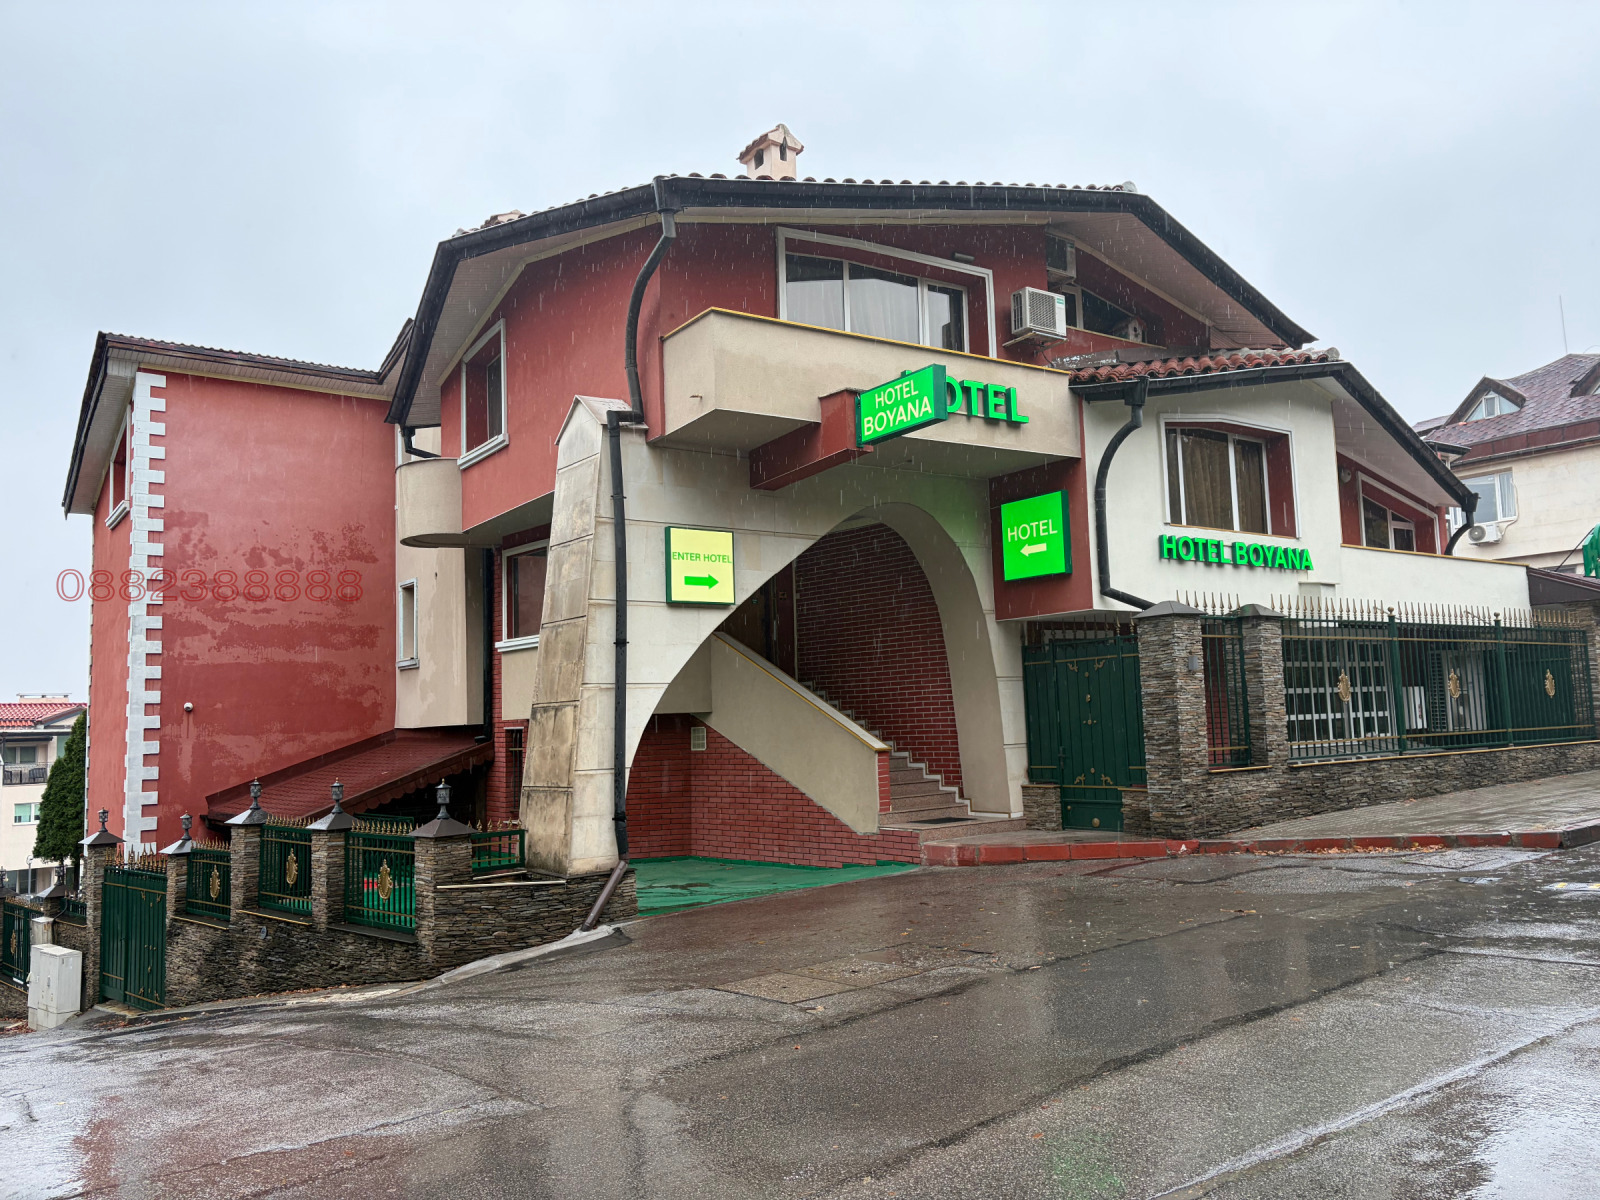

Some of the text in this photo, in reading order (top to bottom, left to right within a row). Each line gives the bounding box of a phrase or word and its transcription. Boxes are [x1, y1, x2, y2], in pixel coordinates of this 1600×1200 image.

[874, 379, 919, 409] HOTEL
[905, 370, 1029, 423] OTEL
[863, 395, 932, 436] BOYANA
[1007, 519, 1058, 543] HOTEL
[672, 551, 732, 564] ENTER HOTEL
[1160, 534, 1314, 571] HOTEL BOYANA
